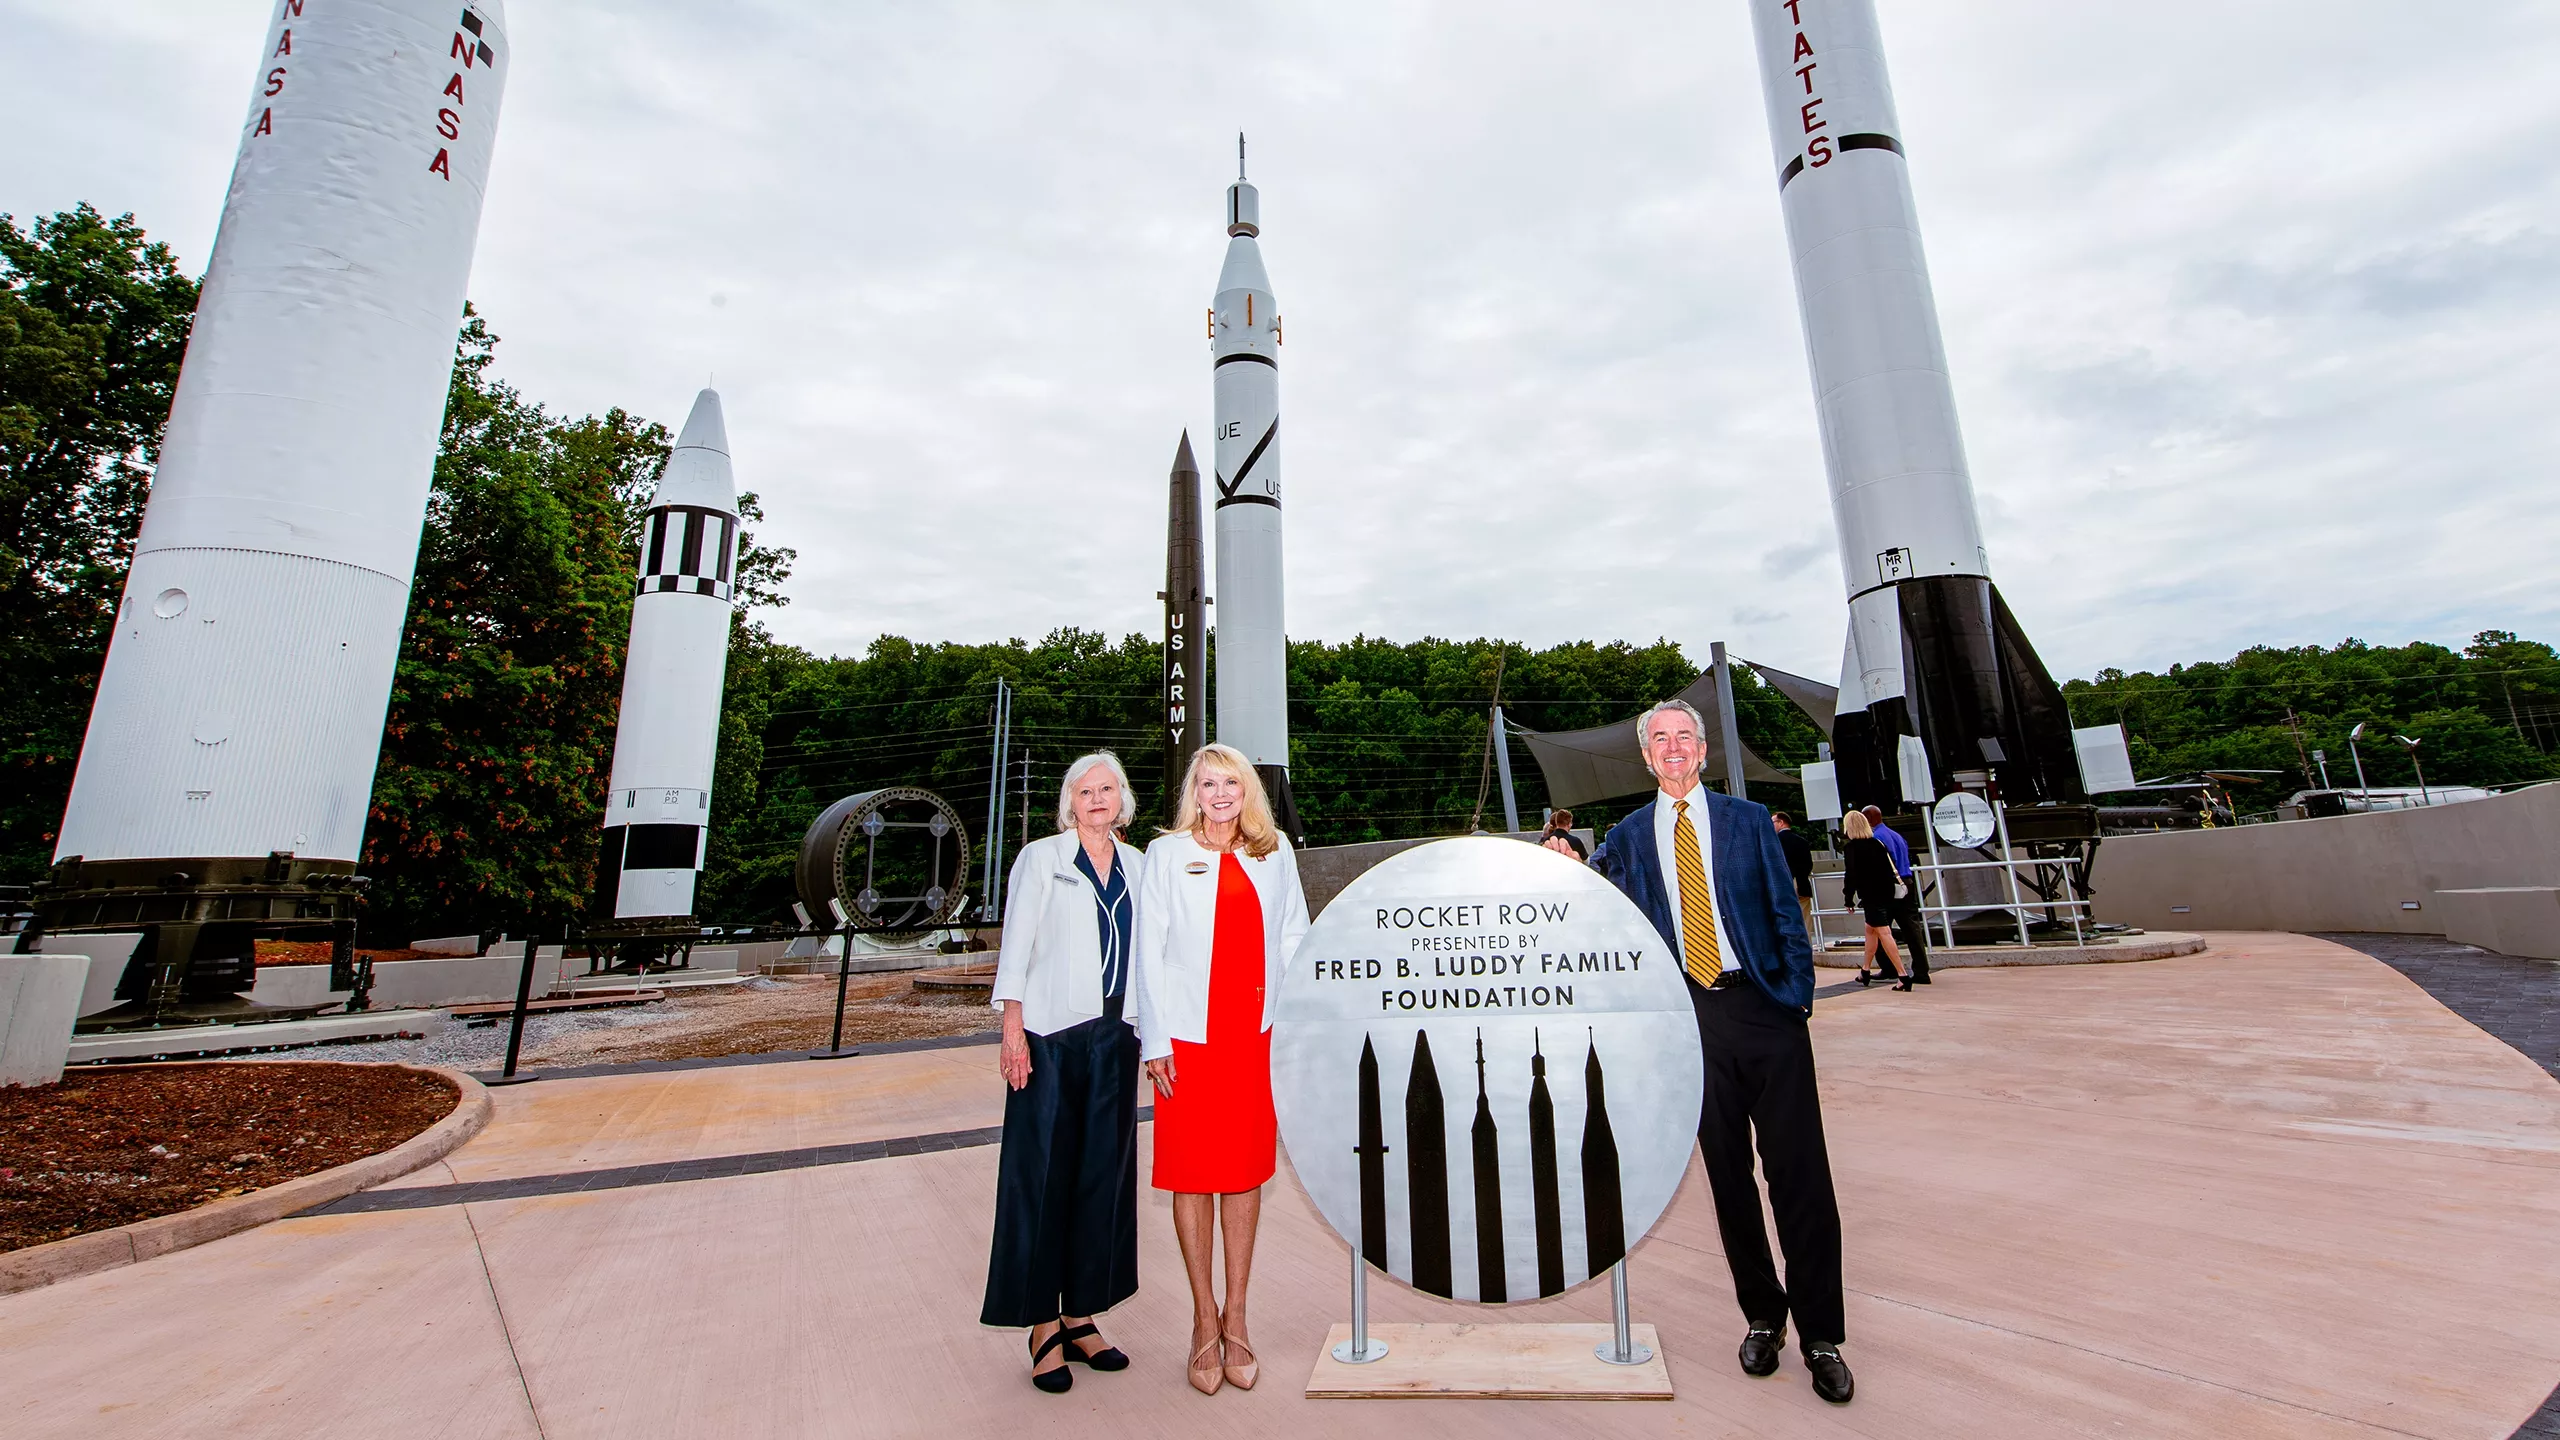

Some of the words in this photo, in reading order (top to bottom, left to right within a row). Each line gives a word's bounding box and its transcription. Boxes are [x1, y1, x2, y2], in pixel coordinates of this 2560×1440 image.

[253, 0, 304, 138] NASA
[428, 31, 475, 182] NASA
[1218, 421, 1241, 441] UE
[1266, 478, 1281, 501] UE
[1886, 554, 1902, 567] MR
[1892, 567, 1899, 577] P
[1171, 613, 1184, 650] US
[1170, 662, 1185, 745] ARMY
[1376, 905, 1484, 929] ROCKET
[1499, 902, 1569, 925] ROW
[1412, 935, 1510, 951] PRESENTED
[1519, 934, 1539, 949] BY
[1315, 959, 1382, 980] FRED
[1397, 958, 1420, 978] B.
[1435, 954, 1525, 977] LUDDY
[1541, 951, 1643, 974] FAMILY
[1382, 985, 1574, 1010] FOUNDATION
